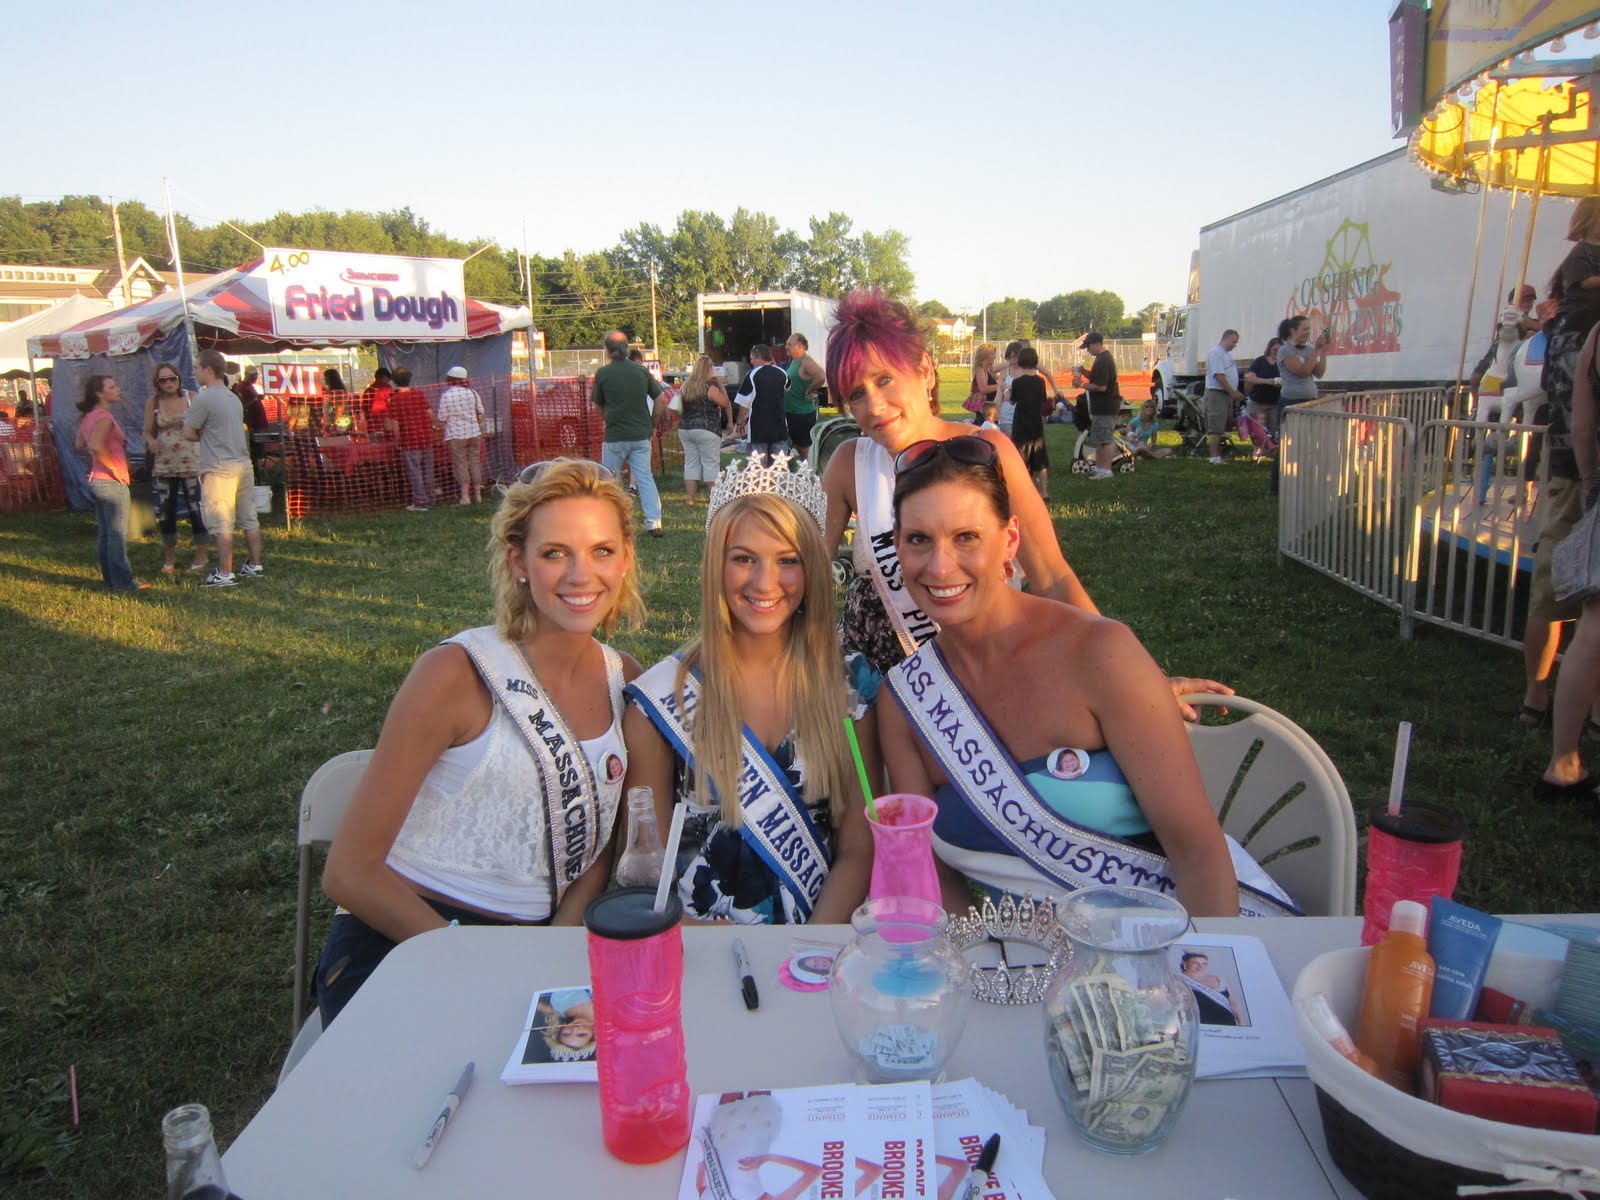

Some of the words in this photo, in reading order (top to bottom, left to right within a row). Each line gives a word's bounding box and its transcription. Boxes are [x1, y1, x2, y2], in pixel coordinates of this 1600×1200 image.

[270, 252, 309, 275] 4.00
[1301, 264, 1379, 307] CUSHING
[286, 285, 365, 321] Fried
[372, 287, 458, 329] Dough
[264, 365, 320, 395] EXIT
[870, 529, 905, 592] MISS
[506, 678, 539, 700] MISS
[900, 653, 936, 703] RS.
[756, 802, 825, 902] MASSAC
[1449, 915, 1481, 932] AVEDA
[821, 1140, 845, 1200] BROOKE
[881, 1140, 906, 1200] BROOKE
[959, 1135, 1000, 1190] BROE
